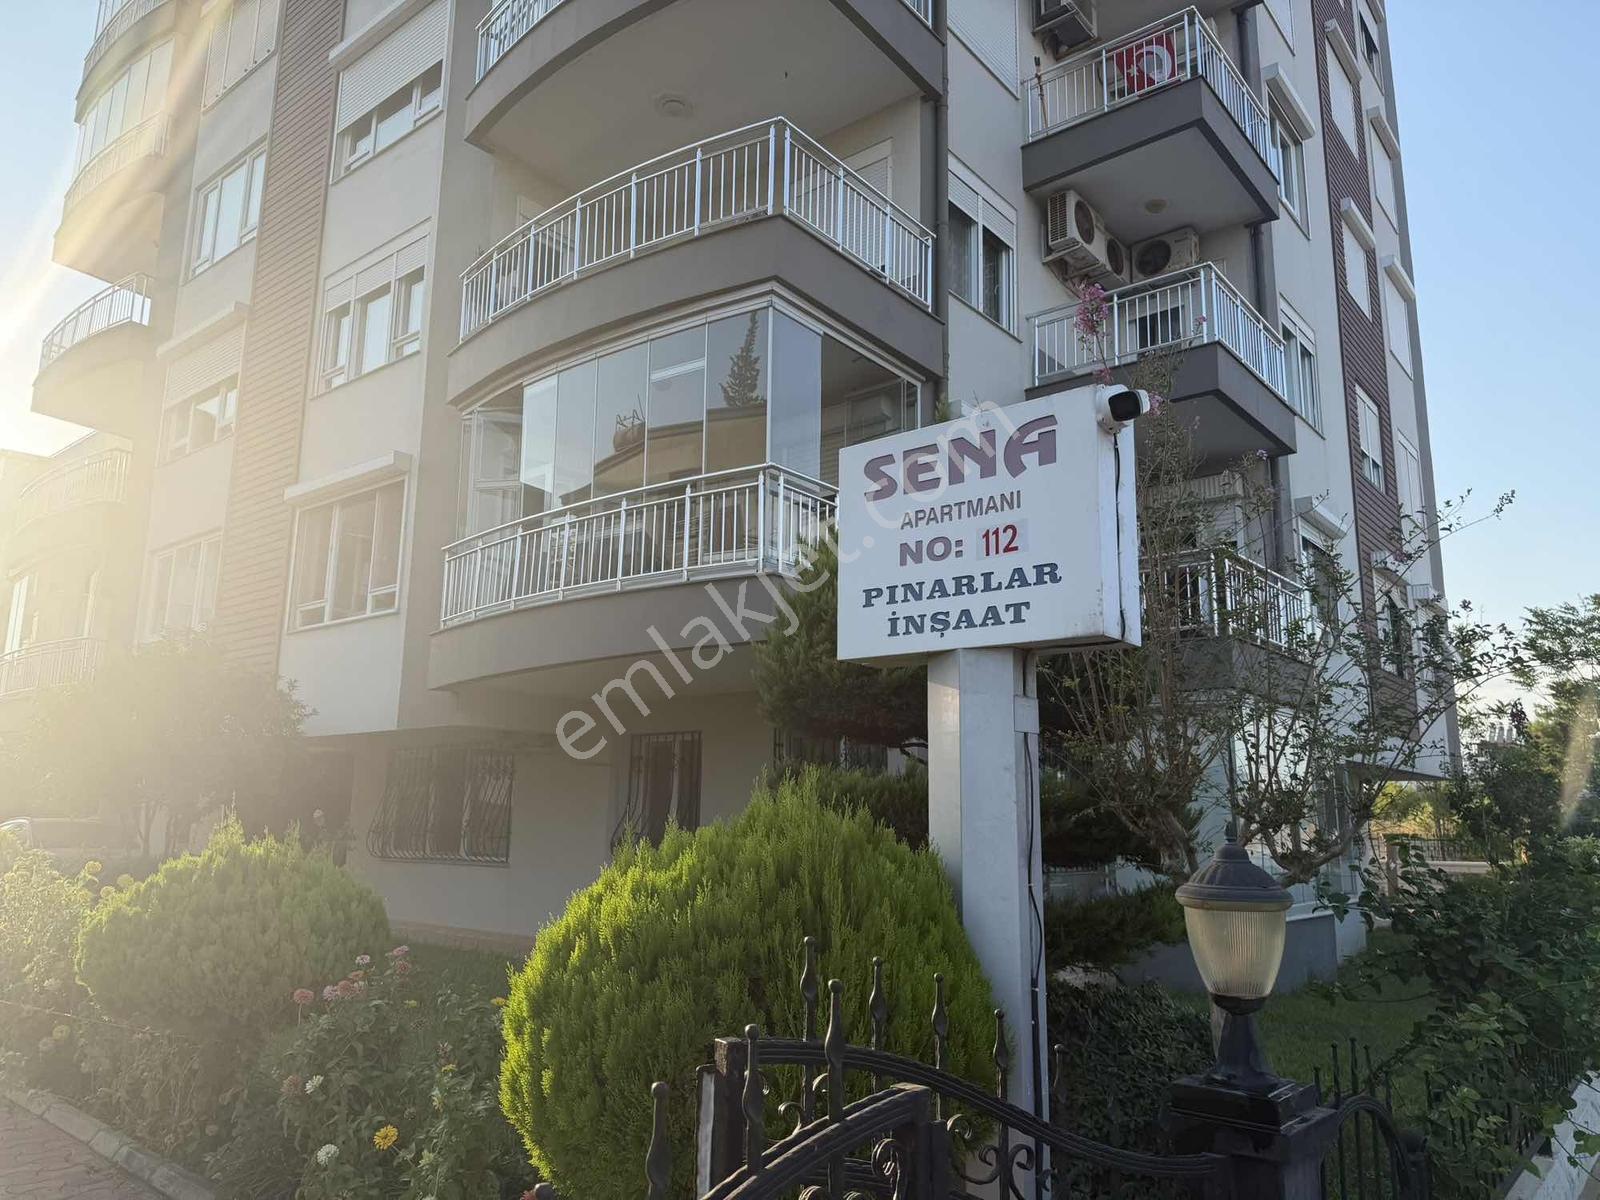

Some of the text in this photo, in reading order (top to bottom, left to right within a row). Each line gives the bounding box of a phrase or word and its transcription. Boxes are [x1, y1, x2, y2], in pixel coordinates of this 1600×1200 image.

[864, 414, 1057, 502] SENA
[900, 490, 1021, 530] APARTMANI
[899, 524, 1019, 566] NO: 112
[862, 562, 1062, 608] PINARLAR
[887, 601, 1031, 638] İNŞAAT
